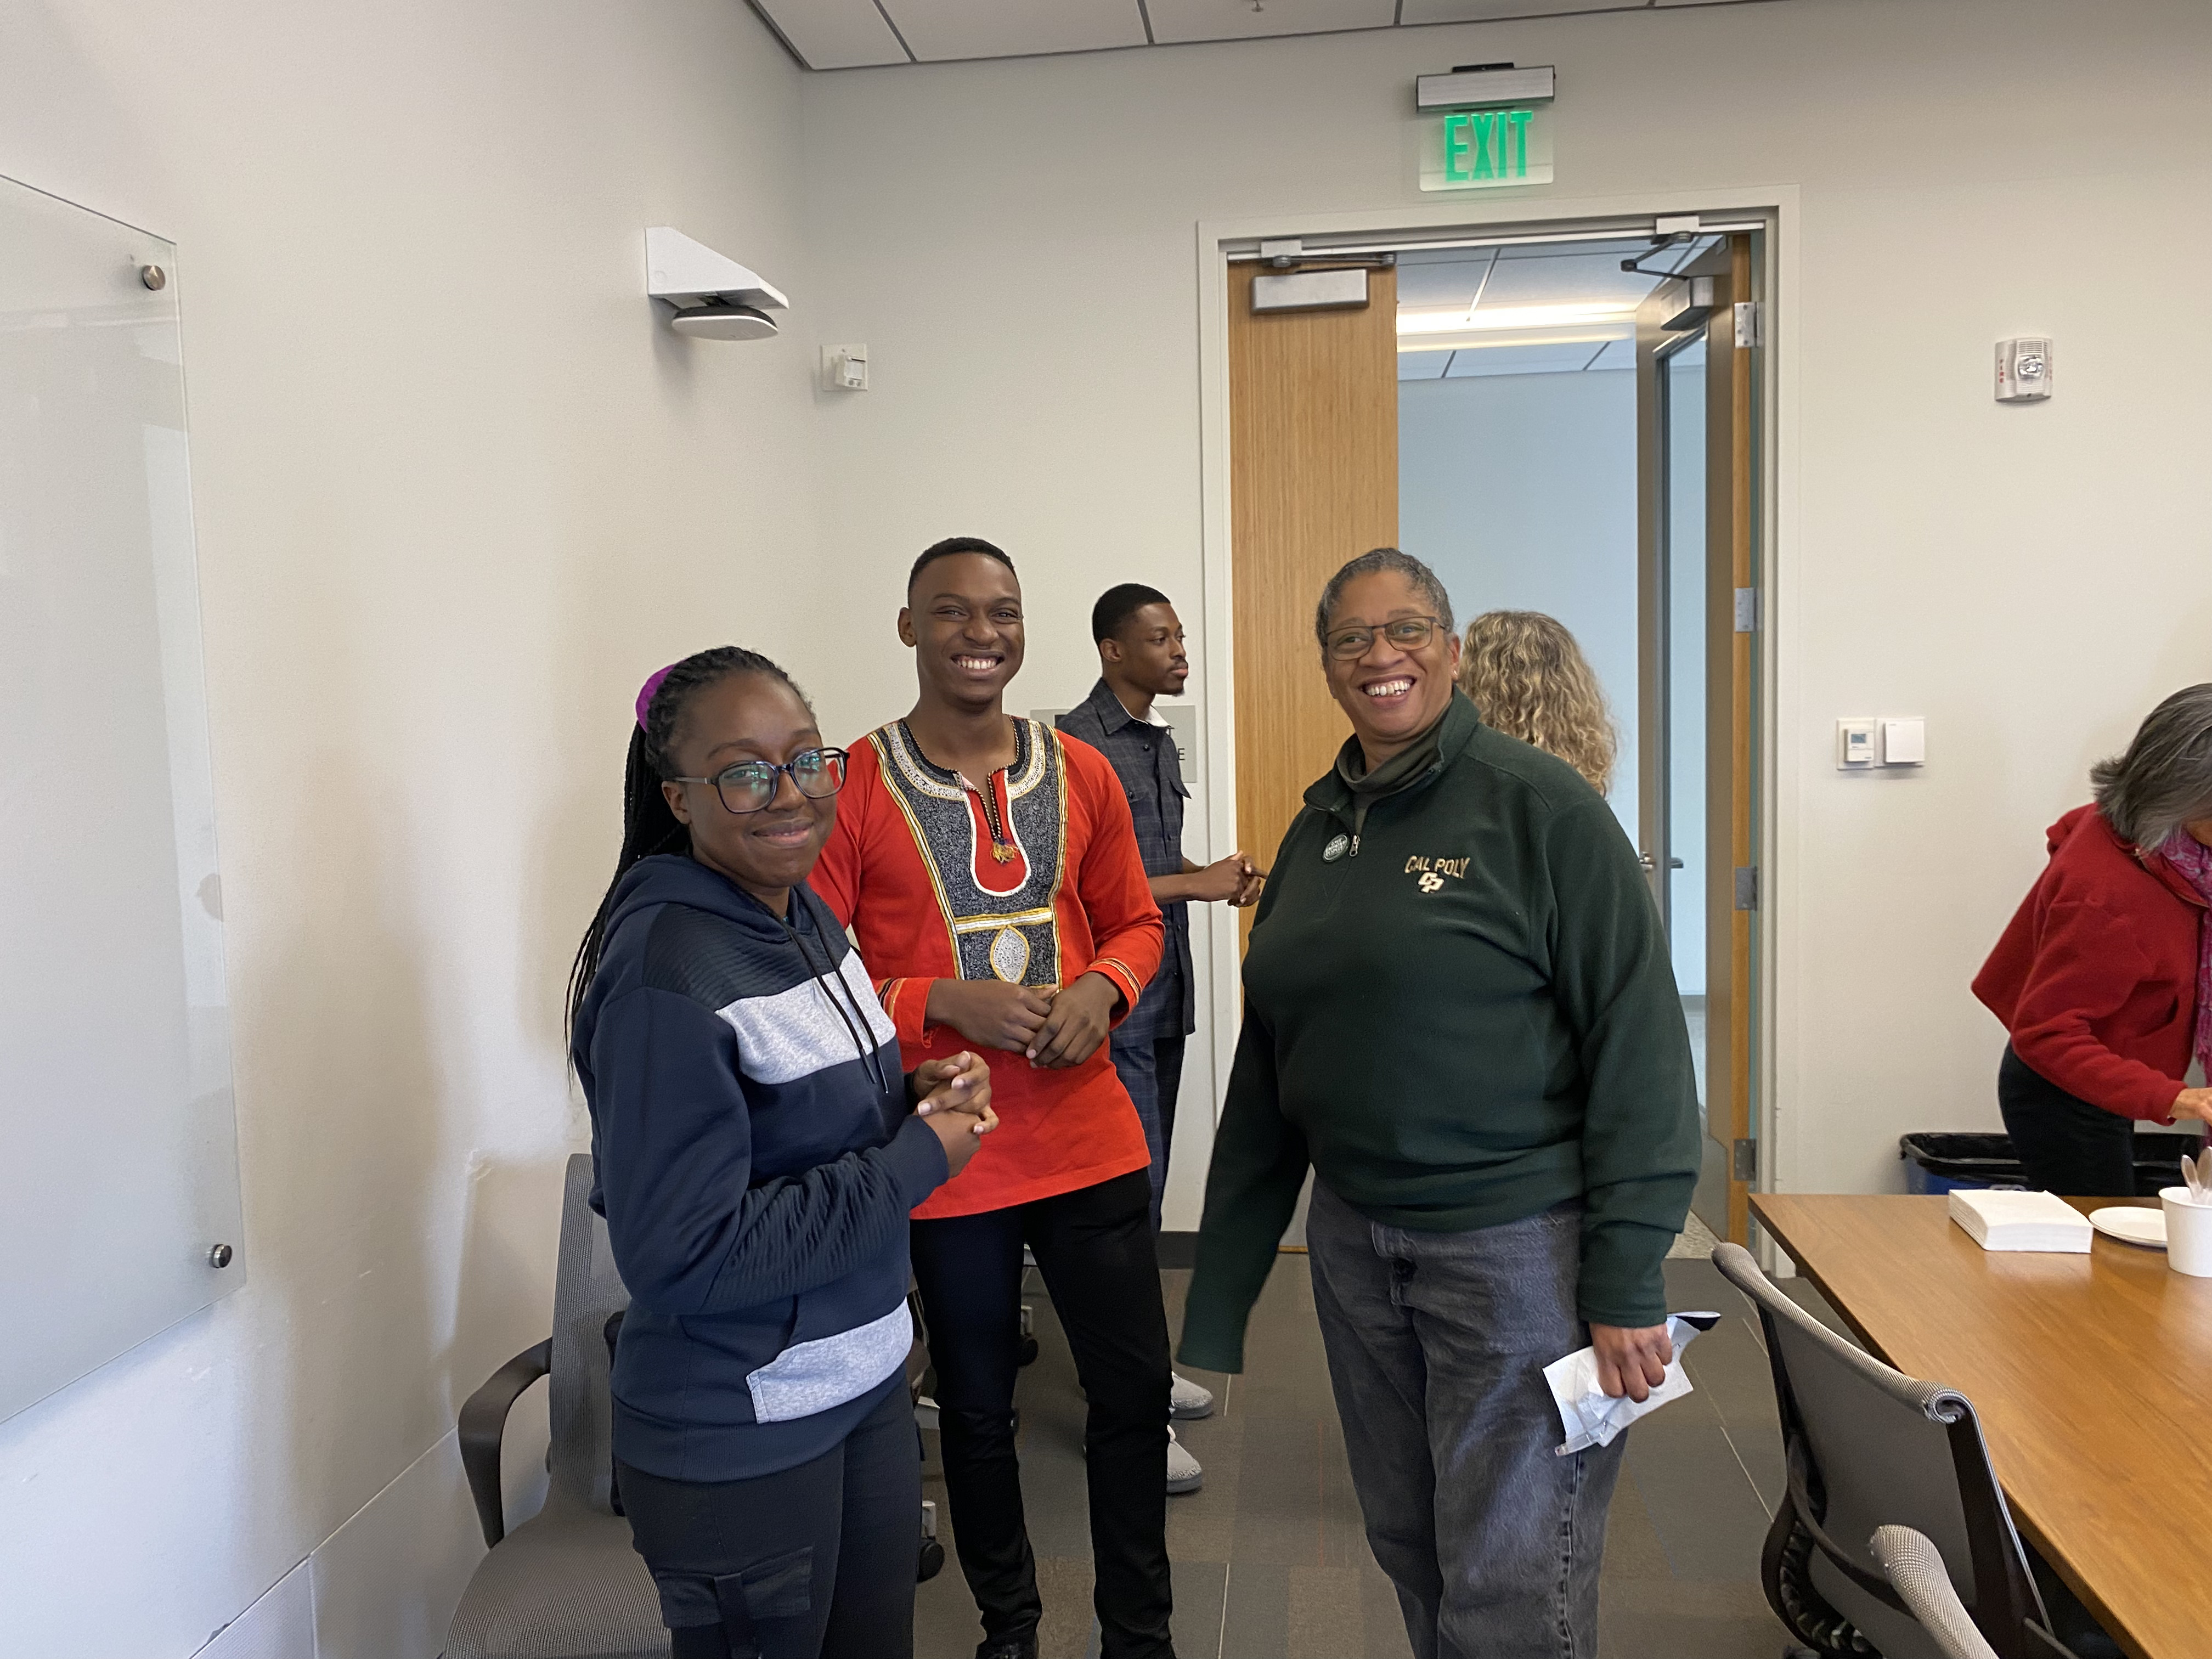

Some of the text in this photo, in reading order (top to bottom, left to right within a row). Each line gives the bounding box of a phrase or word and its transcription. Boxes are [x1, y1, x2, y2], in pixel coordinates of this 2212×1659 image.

[1444, 111, 1532, 182] EXIT
[1404, 855, 1470, 879] CAL POLY
